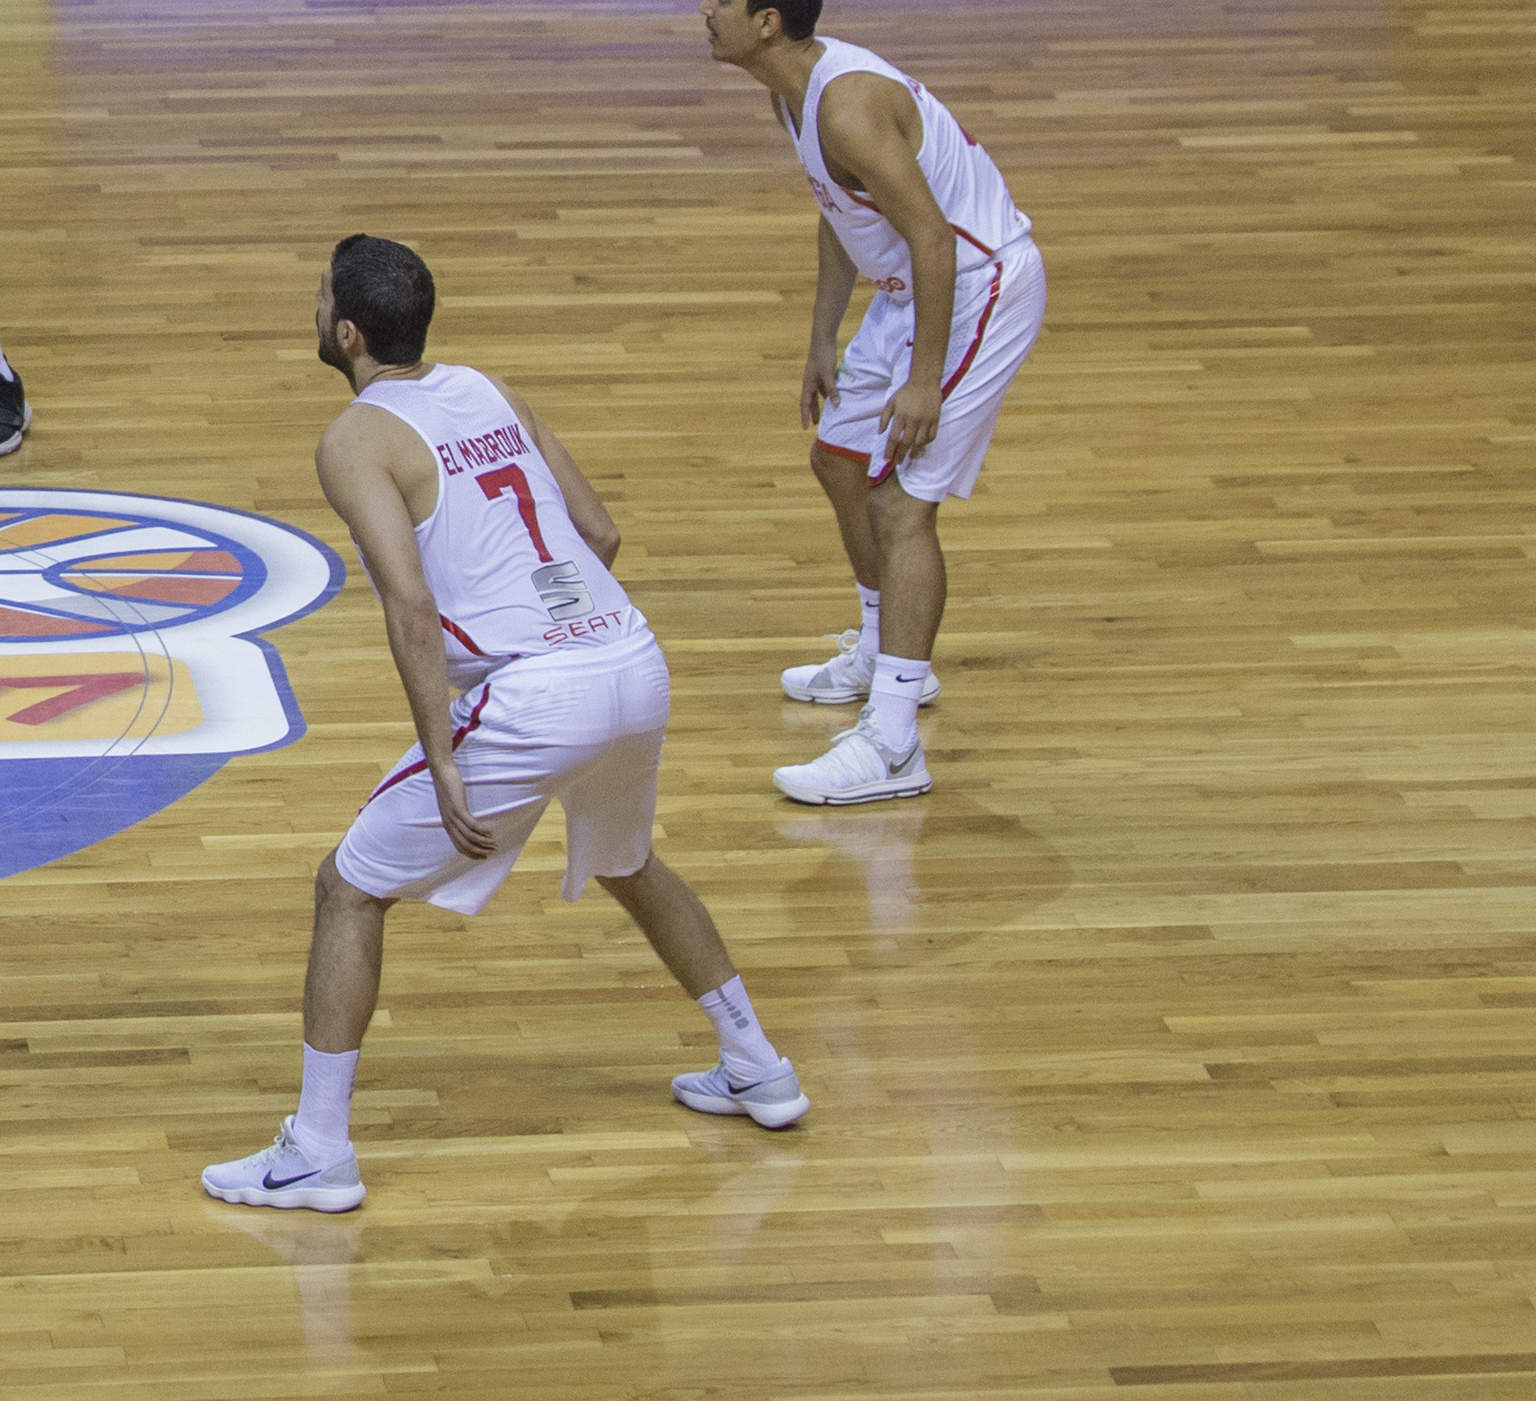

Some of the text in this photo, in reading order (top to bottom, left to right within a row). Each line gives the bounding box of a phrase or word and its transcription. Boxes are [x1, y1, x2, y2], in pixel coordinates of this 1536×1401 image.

[437, 423, 531, 476] EL MABROUK
[474, 463, 554, 563] 7
[543, 611, 622, 647] SEAT
